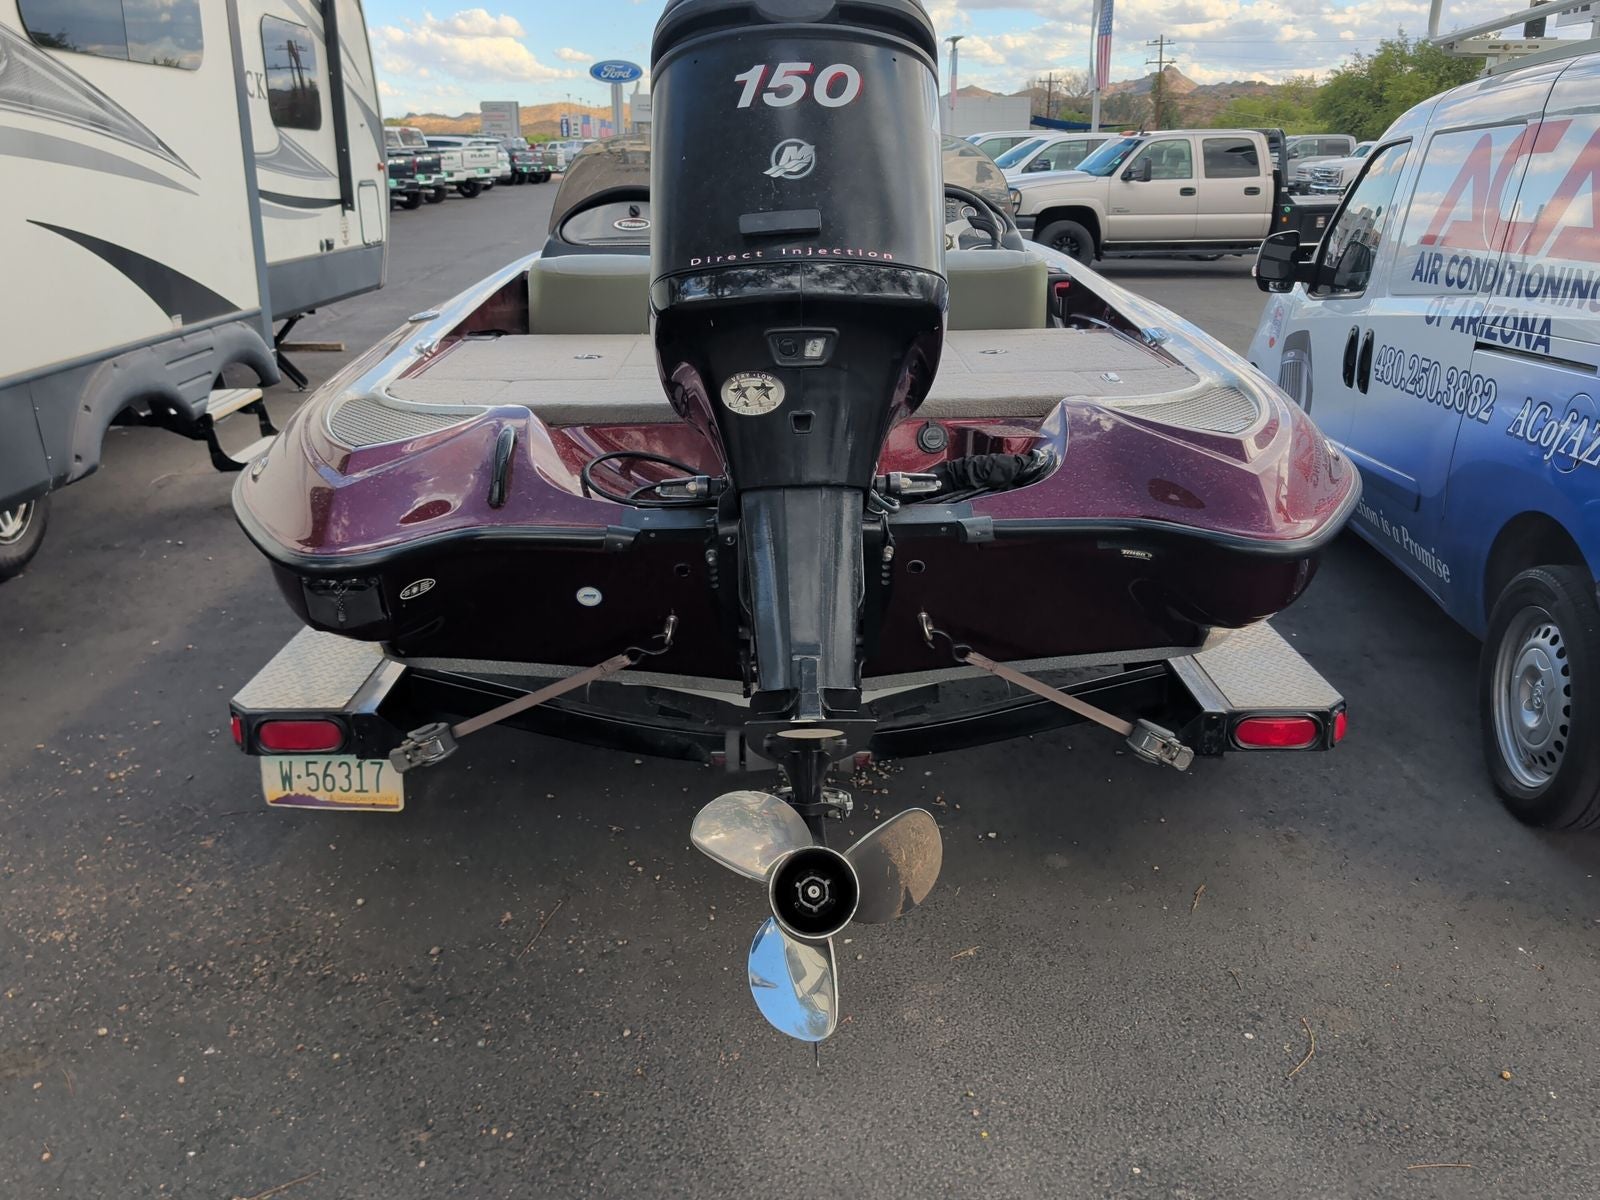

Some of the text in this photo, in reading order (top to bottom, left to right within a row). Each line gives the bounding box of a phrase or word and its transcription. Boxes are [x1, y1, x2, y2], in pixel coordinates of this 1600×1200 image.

[600, 64, 633, 79] Ford
[734, 62, 864, 109] 150
[690, 247, 893, 266] Direct Injection
[1411, 251, 1444, 285] AIR
[1425, 296, 1552, 353] OF ARIZONA
[757, 373, 774, 381] LOW
[1374, 345, 1497, 424] 480.250.3882
[1380, 510, 1391, 537] is
[1392, 526, 1401, 545] a
[1401, 525, 1451, 584] Promise
